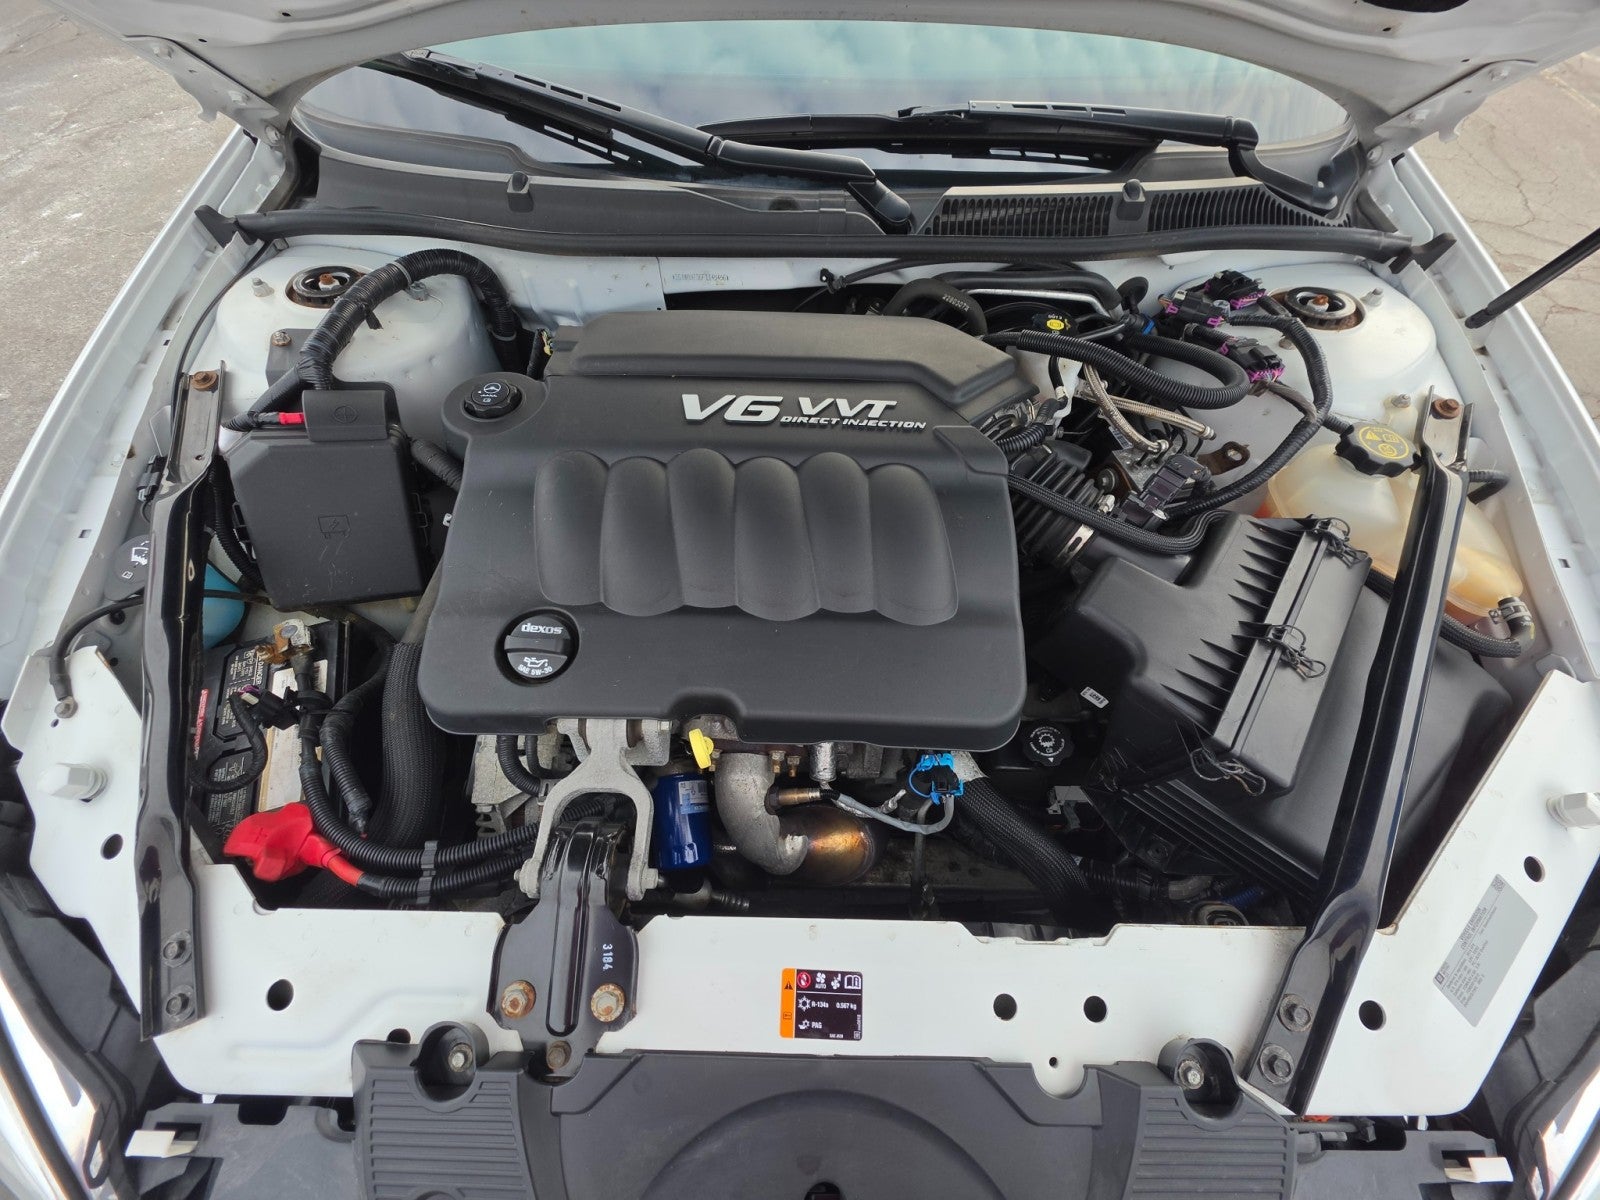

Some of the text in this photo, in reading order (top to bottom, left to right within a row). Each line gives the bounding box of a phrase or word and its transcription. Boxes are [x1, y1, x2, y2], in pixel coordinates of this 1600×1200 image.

[682, 394, 783, 421] V6
[798, 397, 897, 418] VVT
[780, 416, 926, 429] DIRECT INJECTION
[521, 623, 563, 634] dexos
[256, 661, 264, 685] DANGER
[517, 664, 553, 675] SAE 5W-30
[850, 1002, 857, 1010] kg
[811, 1021, 822, 1029] PAG
